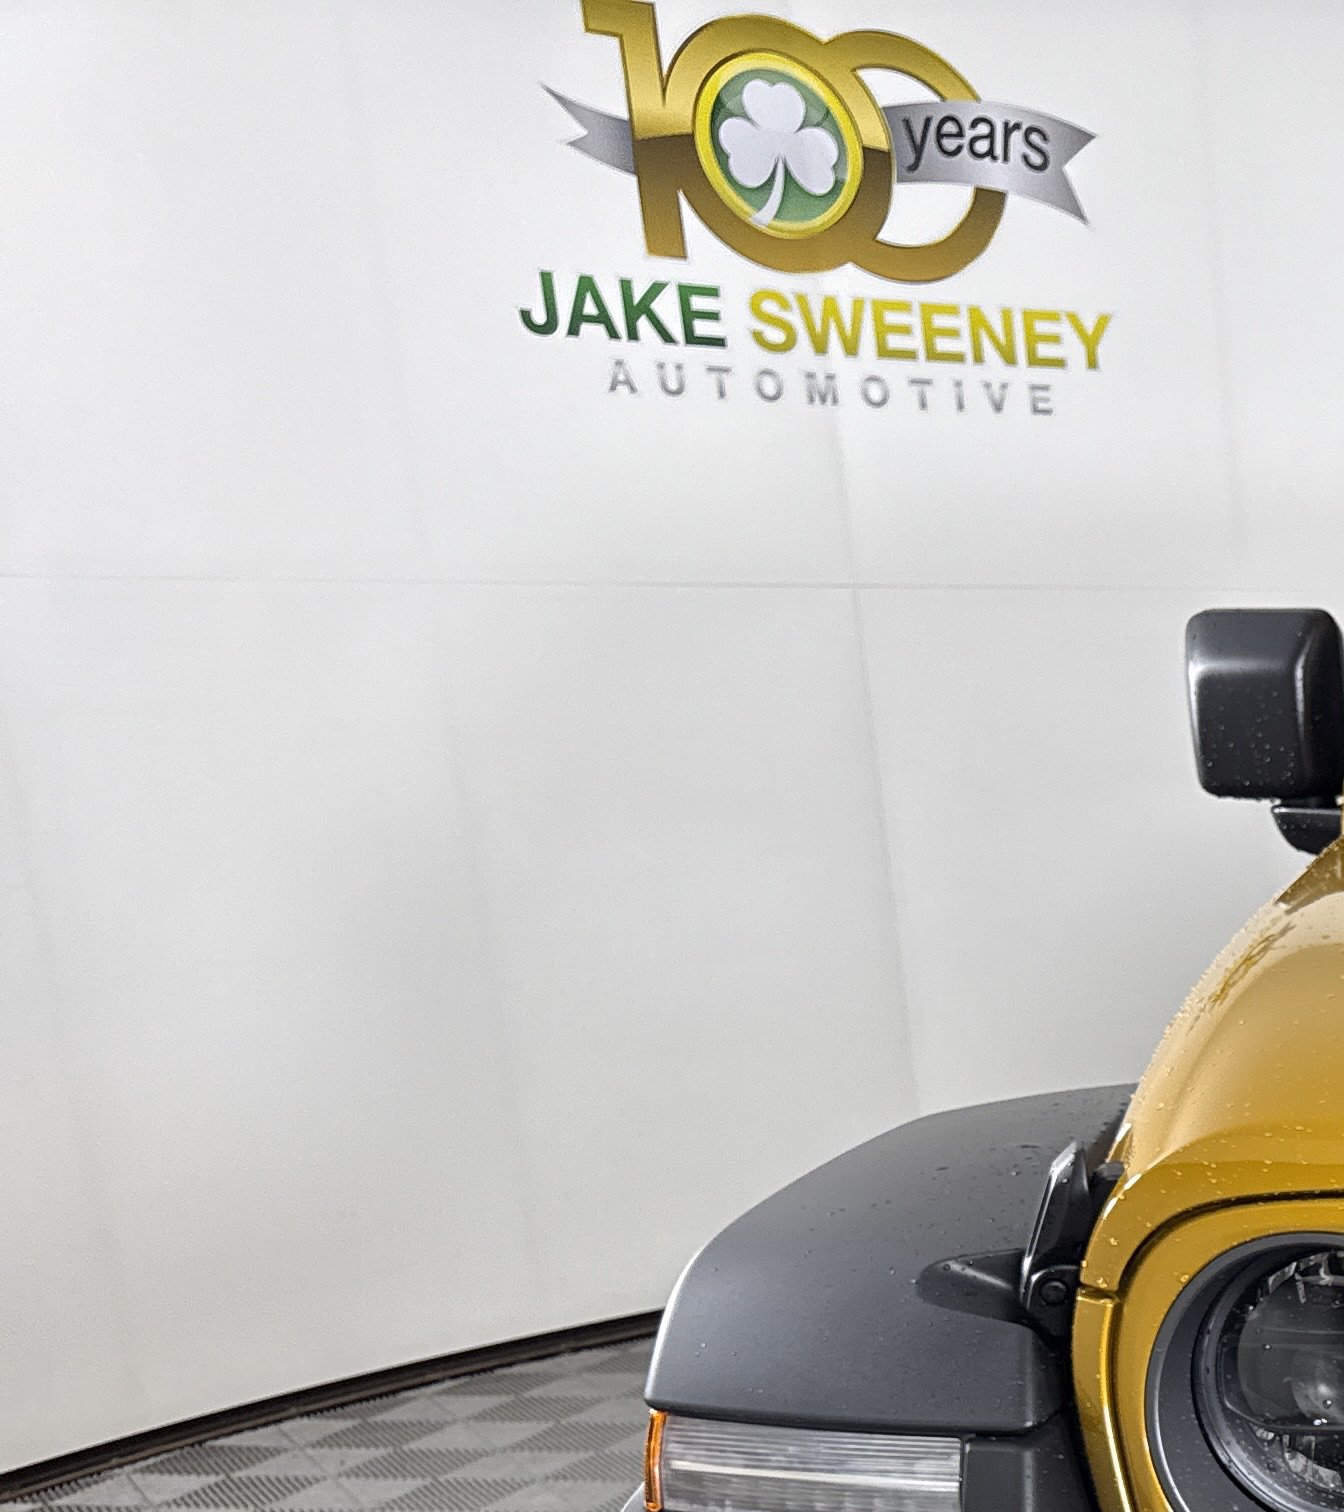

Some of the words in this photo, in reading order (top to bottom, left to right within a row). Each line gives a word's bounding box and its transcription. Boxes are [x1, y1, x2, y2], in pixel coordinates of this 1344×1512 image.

[901, 112, 1051, 173] years
[519, 270, 726, 348] JAKE
[749, 288, 1112, 370] SWEENEY
[608, 358, 1054, 416] AUTOMOTIVE
